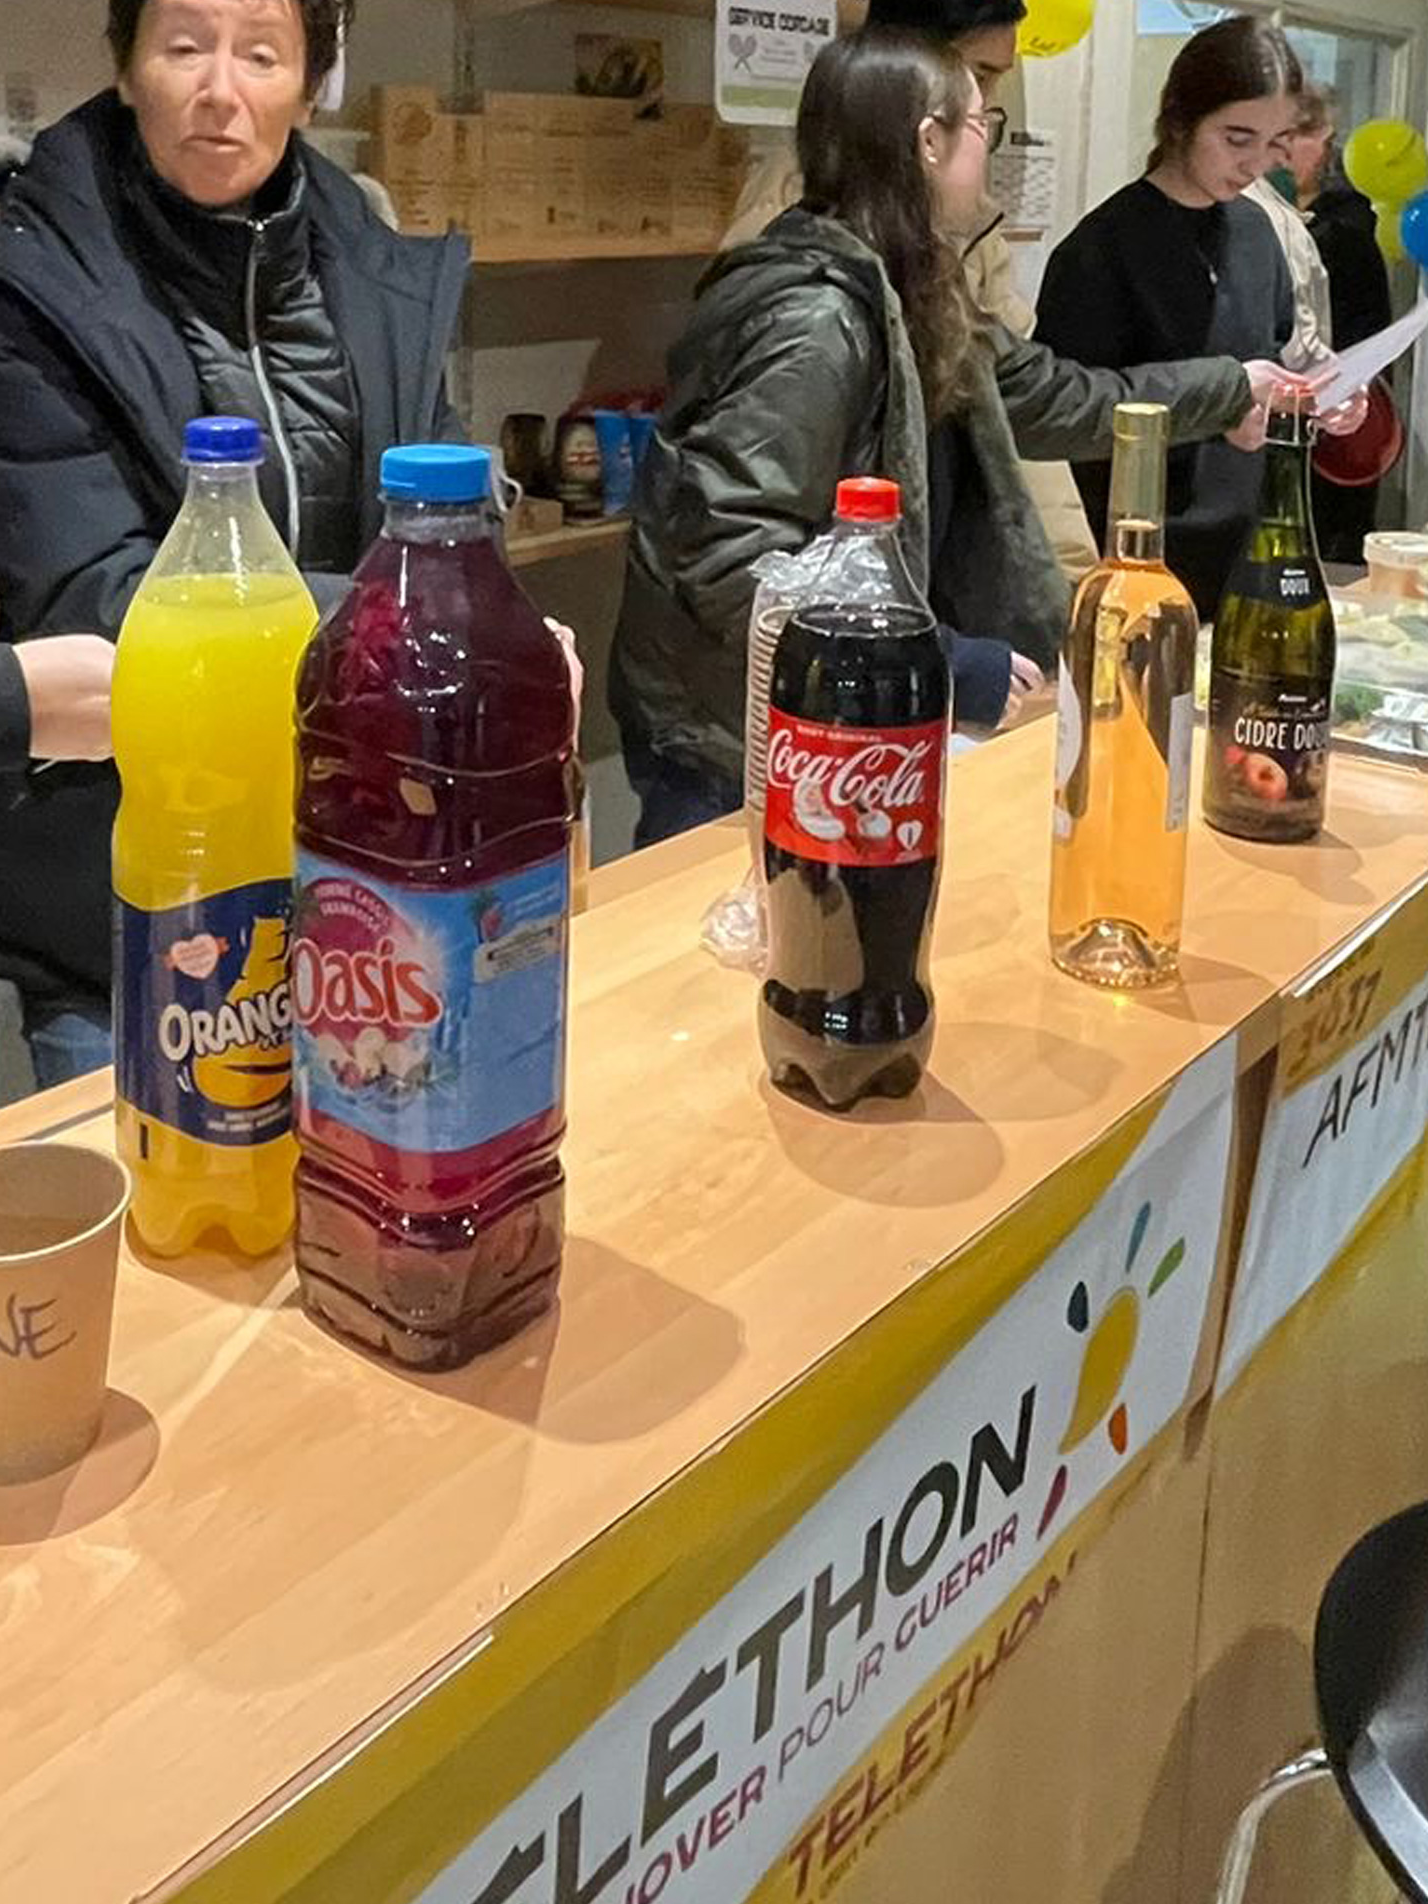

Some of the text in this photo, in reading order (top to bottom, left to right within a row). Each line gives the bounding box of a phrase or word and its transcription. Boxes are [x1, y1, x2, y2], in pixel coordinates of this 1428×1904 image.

[767, 728, 933, 808] Coca-Cola
[1234, 716, 1289, 750] CIDRE
[291, 936, 443, 1028] Oasis
[626, 1765, 769, 1904] OVER
[778, 1641, 884, 1782] POUR
